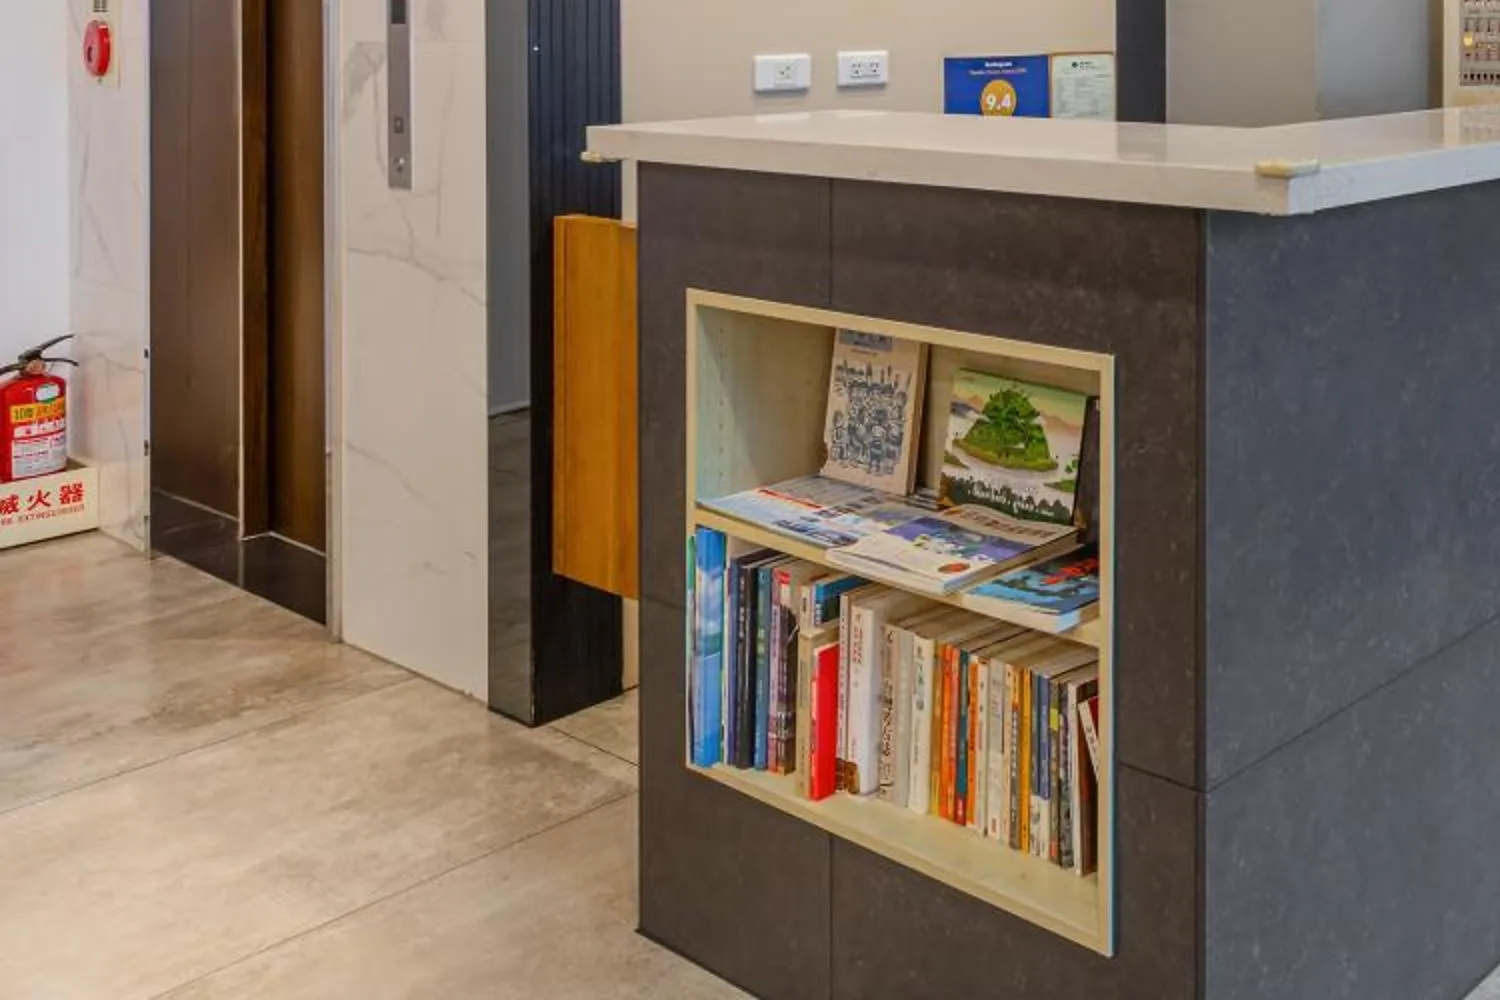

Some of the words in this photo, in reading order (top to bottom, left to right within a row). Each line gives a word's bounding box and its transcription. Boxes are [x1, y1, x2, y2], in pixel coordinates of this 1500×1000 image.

[985, 94, 1012, 111] 9.4
[0, 482, 84, 514] 滅火器
